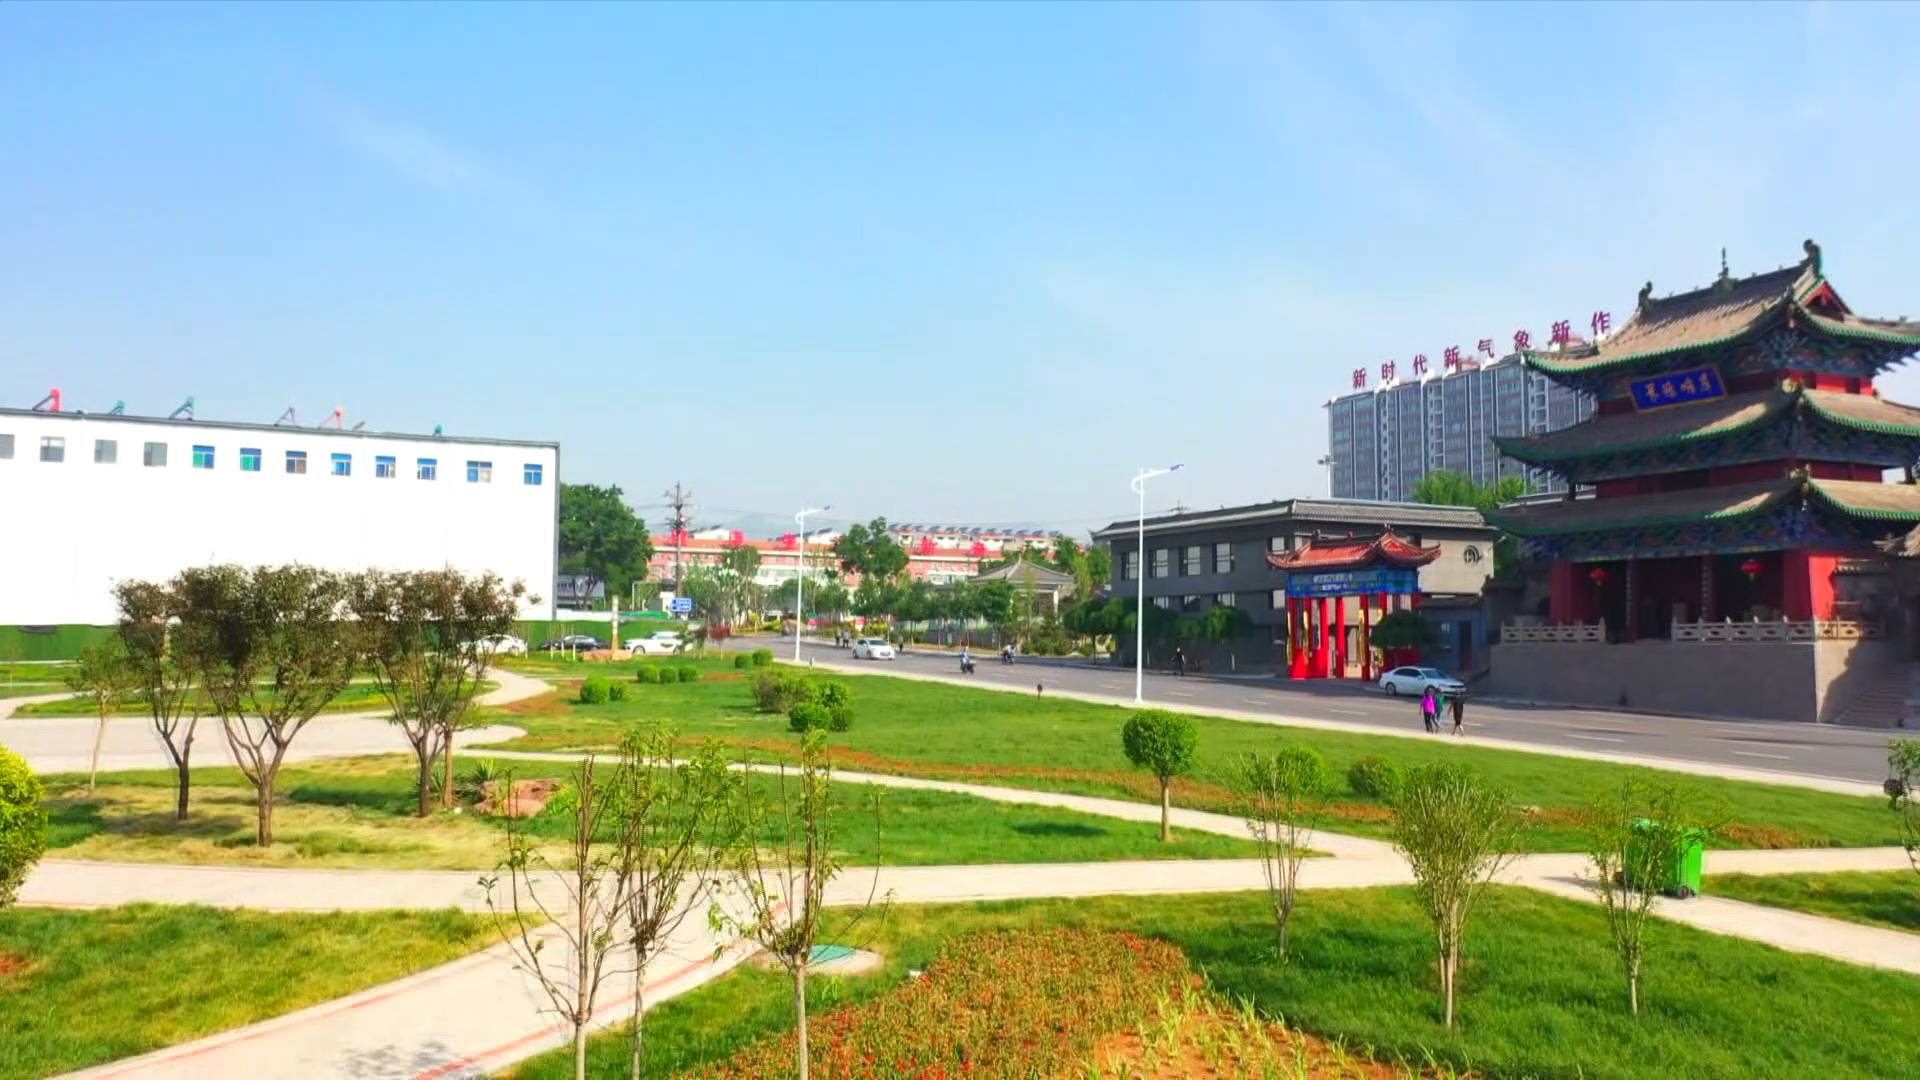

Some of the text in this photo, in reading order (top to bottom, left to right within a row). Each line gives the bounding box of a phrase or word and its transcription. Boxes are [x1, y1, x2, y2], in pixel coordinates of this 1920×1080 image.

[1352, 311, 1611, 388] 新时代新气象新作
